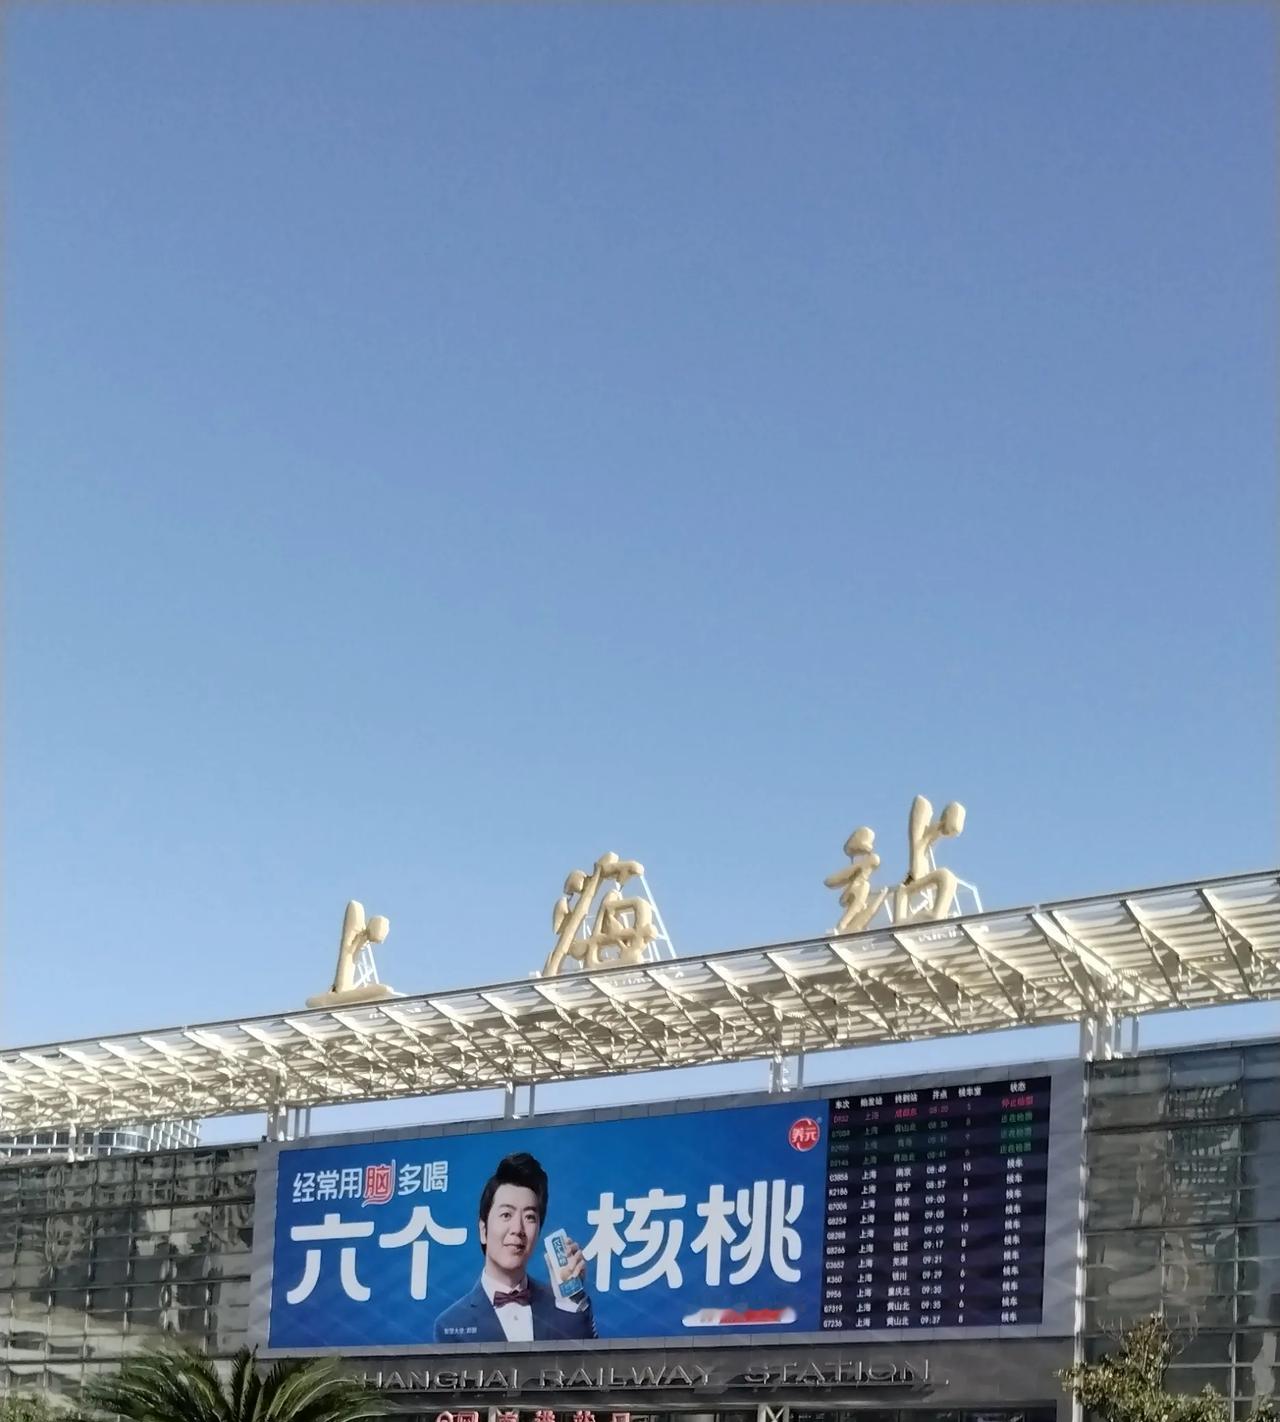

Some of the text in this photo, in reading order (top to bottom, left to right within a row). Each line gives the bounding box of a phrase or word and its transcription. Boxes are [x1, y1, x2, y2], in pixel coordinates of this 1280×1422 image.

[307, 794, 967, 1007] 上海站
[836, 1100, 849, 1109] 车次
[865, 1111, 879, 1120] 上海
[862, 1170, 876, 1179] 上海
[963, 1163, 971, 1171] 10
[293, 1161, 448, 1206] 经常用脑多喝
[861, 1185, 876, 1194] 上海
[861, 1200, 875, 1209] 上海
[926, 1195, 945, 1204] 09:00
[860, 1215, 874, 1224] 上海
[860, 1229, 874, 1238] 上海
[924, 1225, 944, 1234] 09:09
[961, 1223, 968, 1232] 10
[287, 1180, 804, 1304] 六个 核桃
[859, 1244, 873, 1253] 上海
[924, 1240, 943, 1249] 09:17
[858, 1259, 873, 1268] 上海
[923, 1255, 941, 1264] 09:21
[858, 1274, 872, 1283] 上海
[923, 1270, 942, 1279] 09:29
[857, 1288, 871, 1297] 上海
[857, 1303, 871, 1312] 上海
[856, 1318, 870, 1327] 上海
[921, 1315, 940, 1324] 09:37
[353, 1359, 929, 1390] HANGHAI RAILWAY STATION
